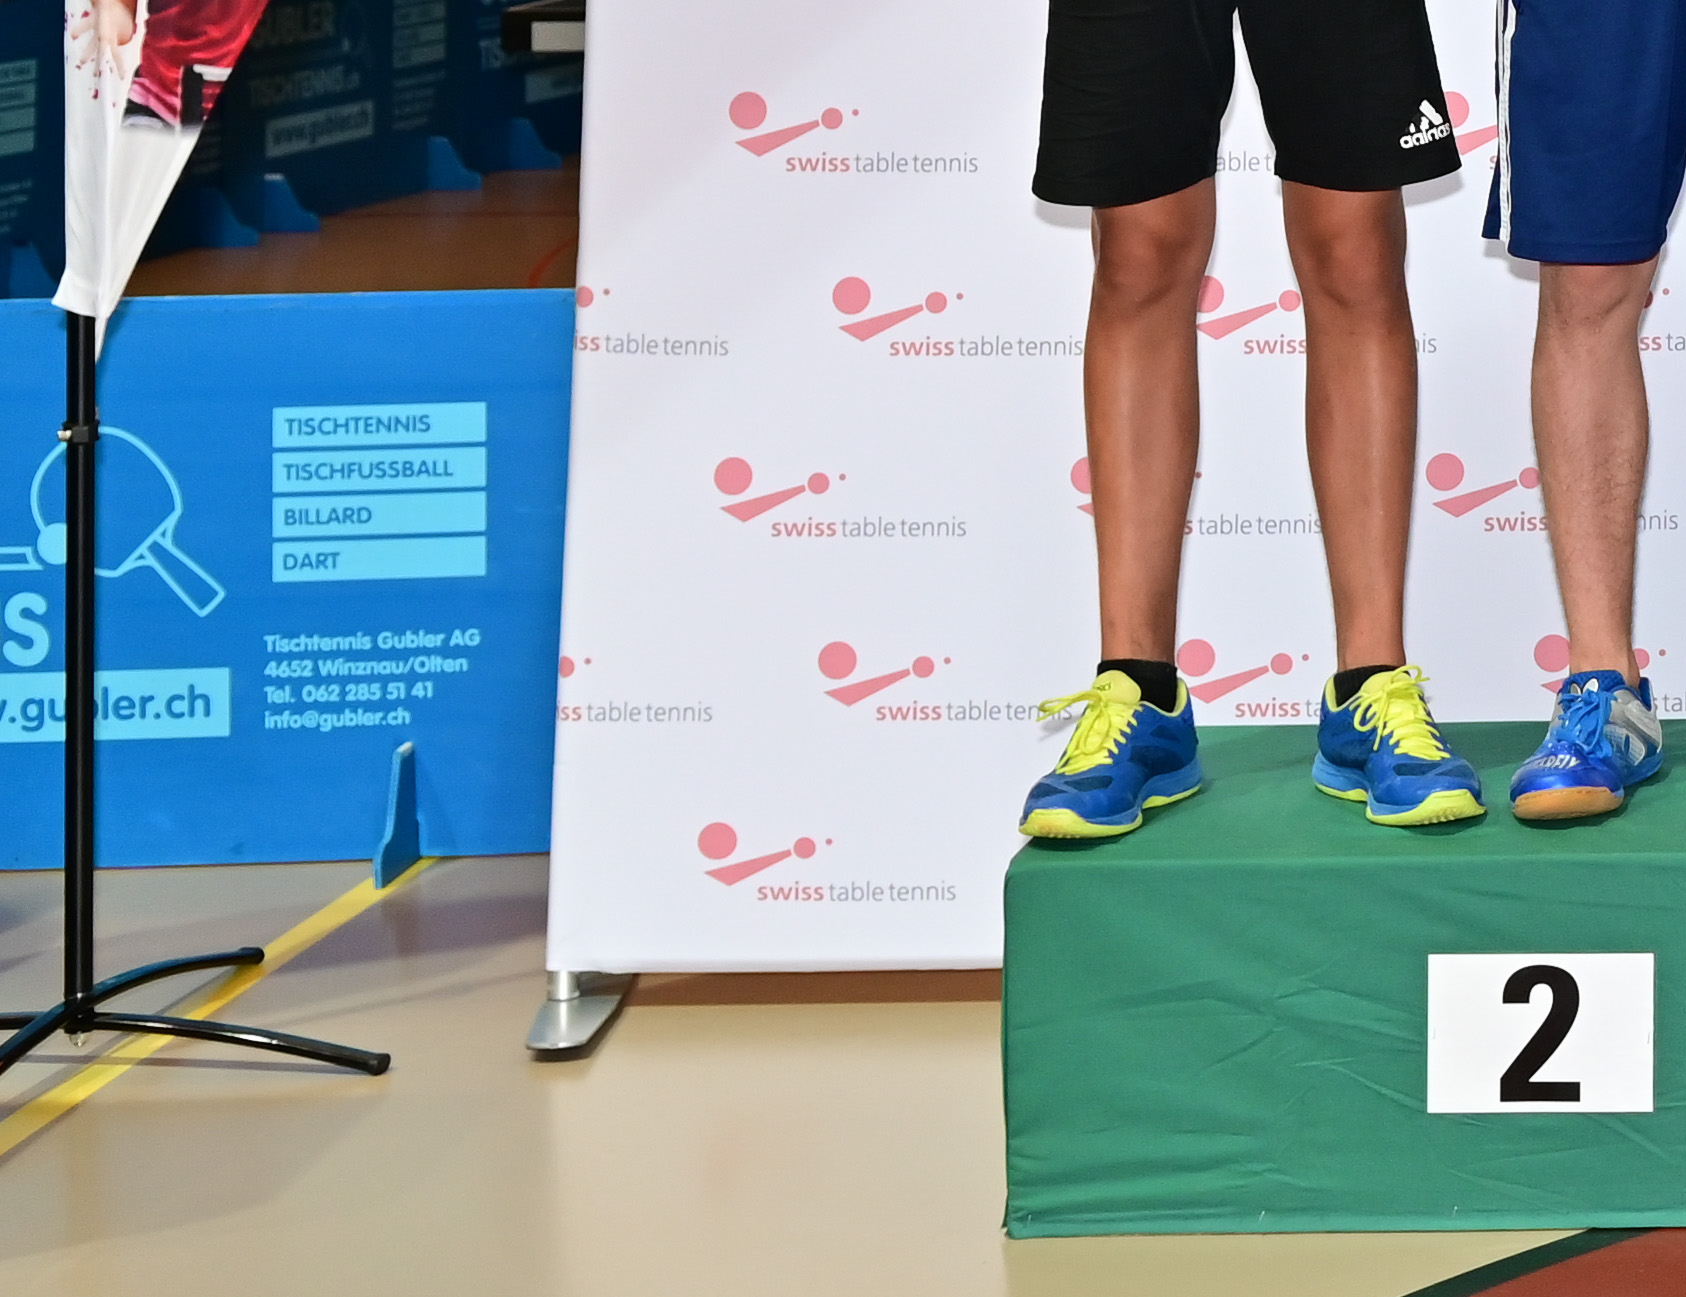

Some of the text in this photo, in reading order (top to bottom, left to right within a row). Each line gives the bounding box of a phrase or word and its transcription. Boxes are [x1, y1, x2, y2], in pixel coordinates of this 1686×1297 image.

[1400, 122, 1451, 149] adidas
[284, 414, 431, 437] TISCHTENNIS
[283, 460, 453, 482] TISCHFUSSBALL
[284, 506, 372, 527] BILLARD
[282, 552, 340, 571] DART
[263, 628, 481, 653] Tischtennis Gubler AG
[263, 656, 468, 679] 4652 Winznau/Olten
[263, 680, 433, 704] Tel. 062 285 51 41
[264, 707, 411, 732] info@gubler.ch
[1499, 964, 1582, 1103] 2
